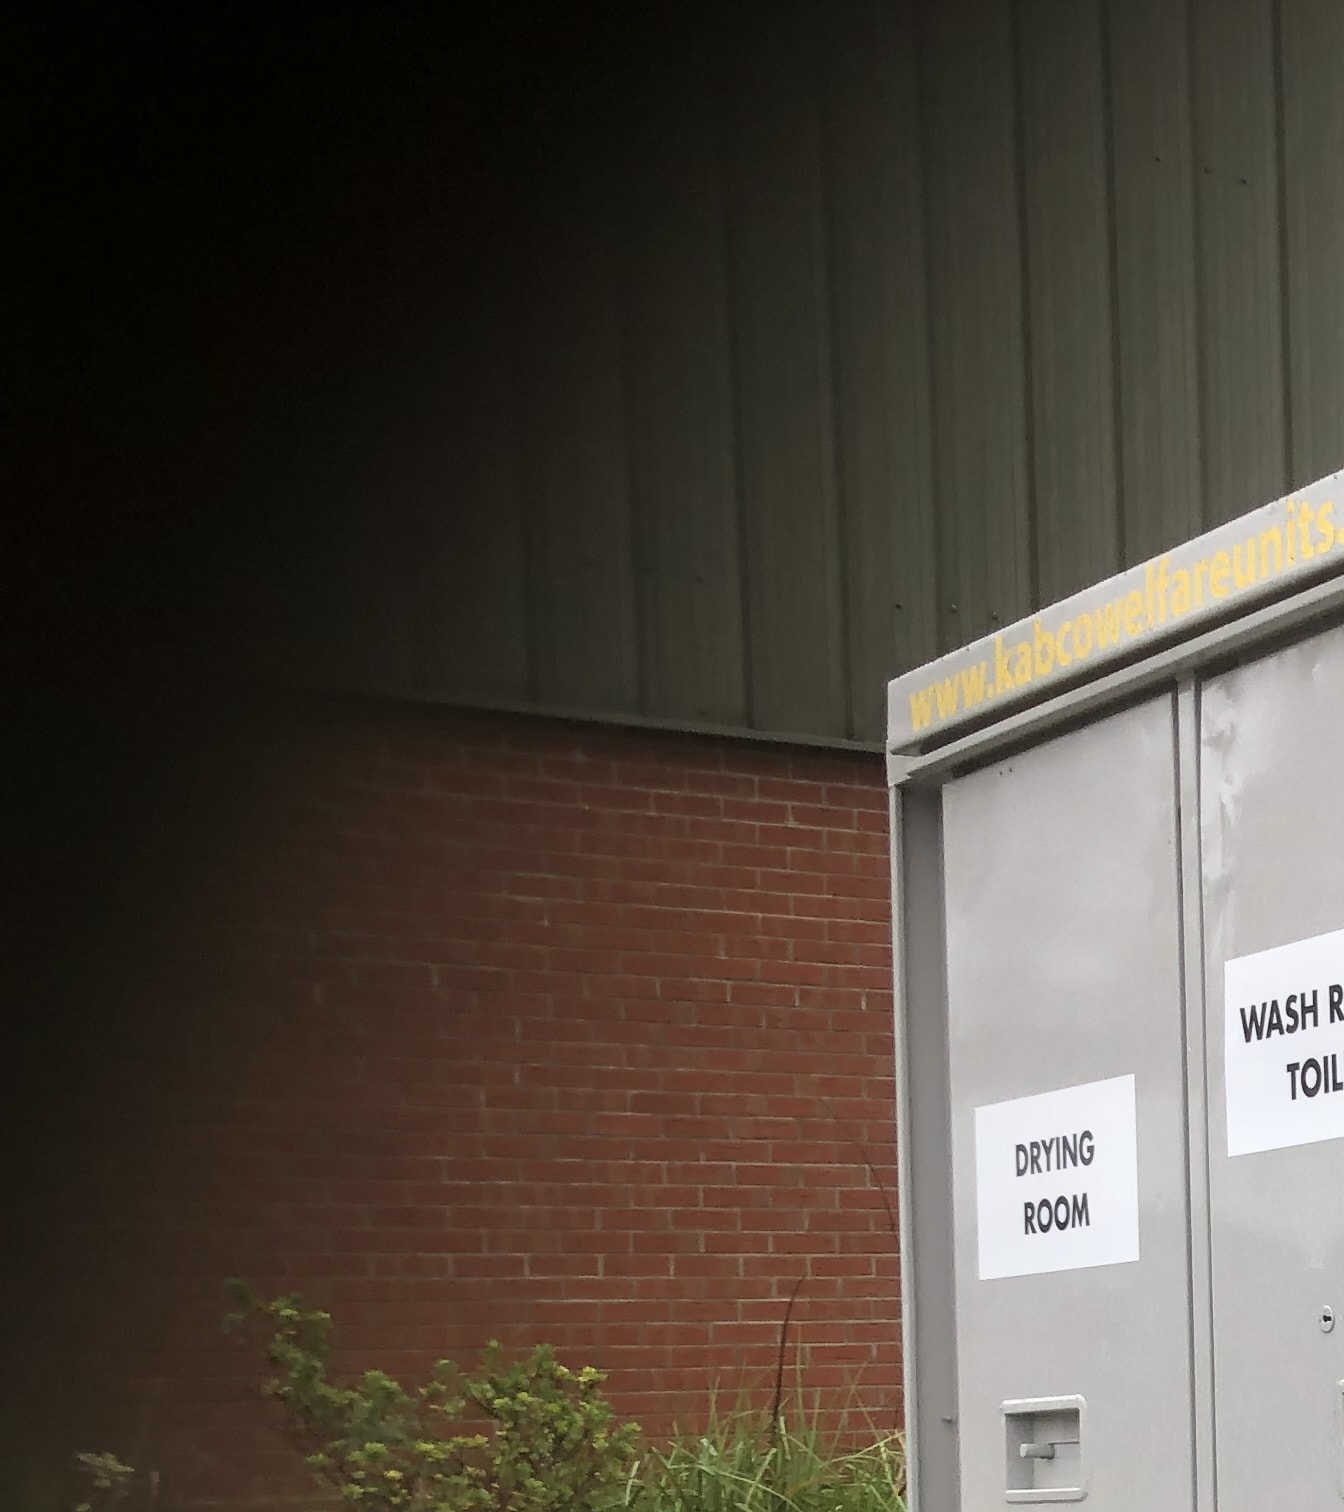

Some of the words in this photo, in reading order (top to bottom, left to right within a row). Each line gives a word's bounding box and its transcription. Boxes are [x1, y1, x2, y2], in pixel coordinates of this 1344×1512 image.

[1239, 990, 1319, 1044] WASH
[1014, 1130, 1096, 1178] DRYING
[1023, 1192, 1091, 1236] ROOM
